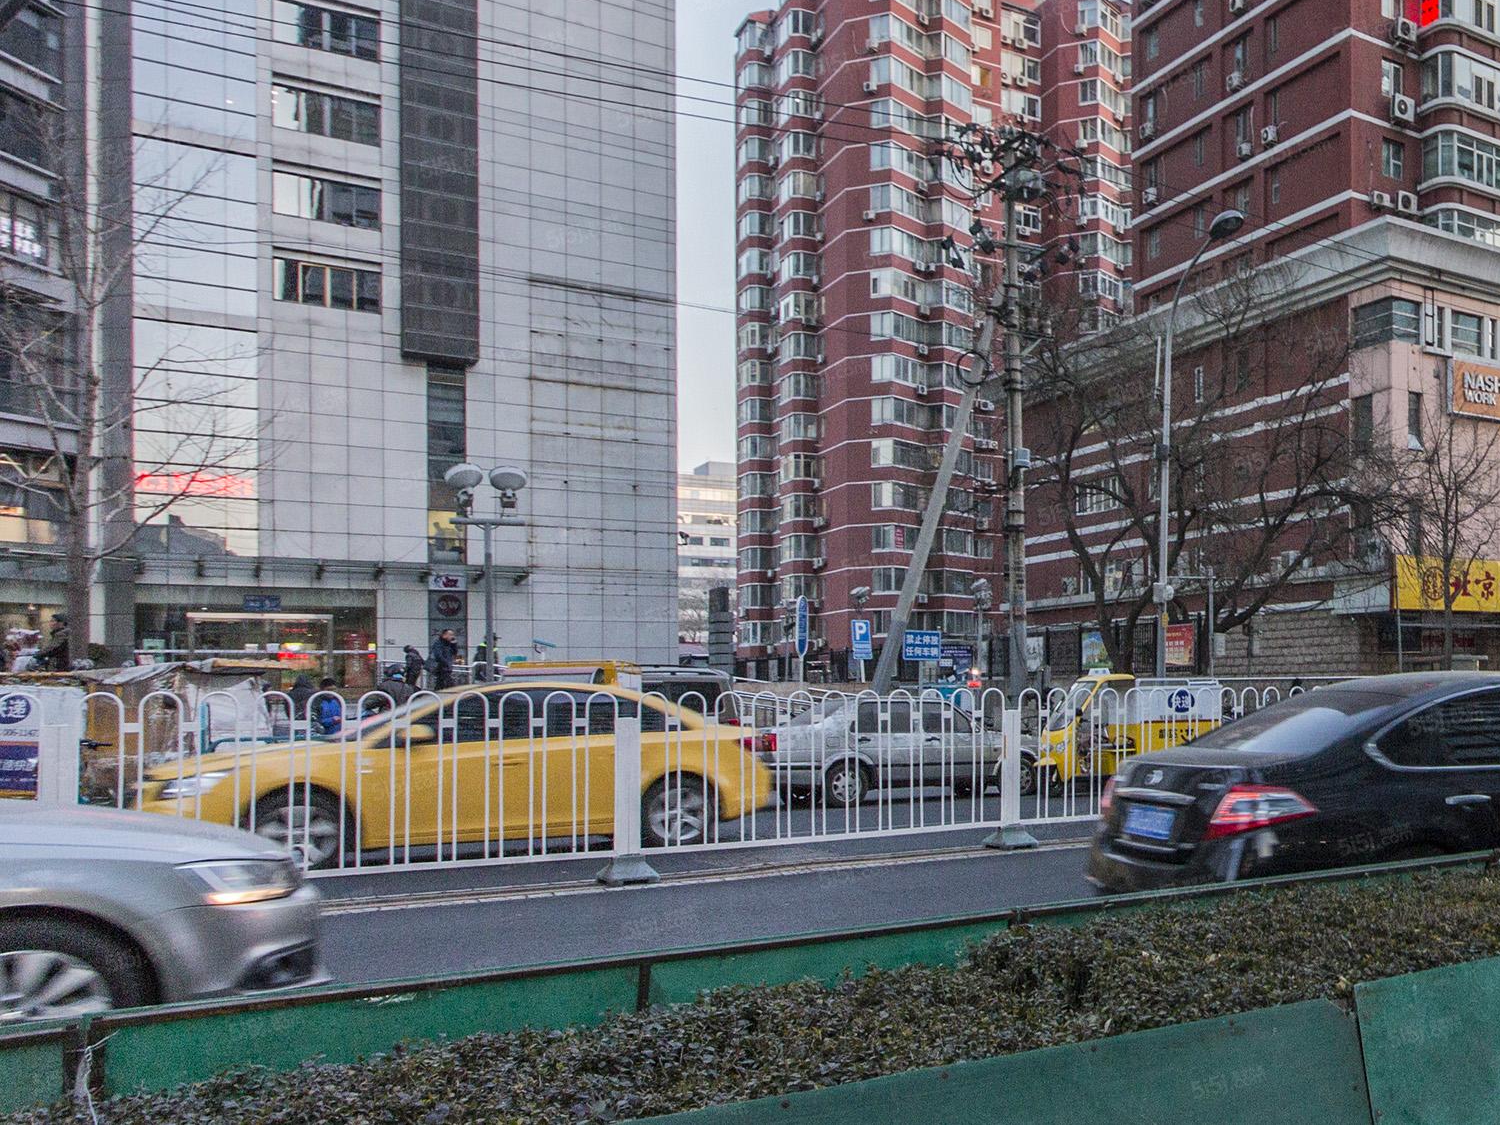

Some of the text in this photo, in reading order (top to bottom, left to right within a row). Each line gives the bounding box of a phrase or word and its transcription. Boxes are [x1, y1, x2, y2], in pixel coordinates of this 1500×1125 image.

[1464, 390, 1497, 406] WORK
[855, 622, 867, 641] P
[905, 634, 939, 645] 禁止停放
[905, 646, 939, 657] 任何车辆
